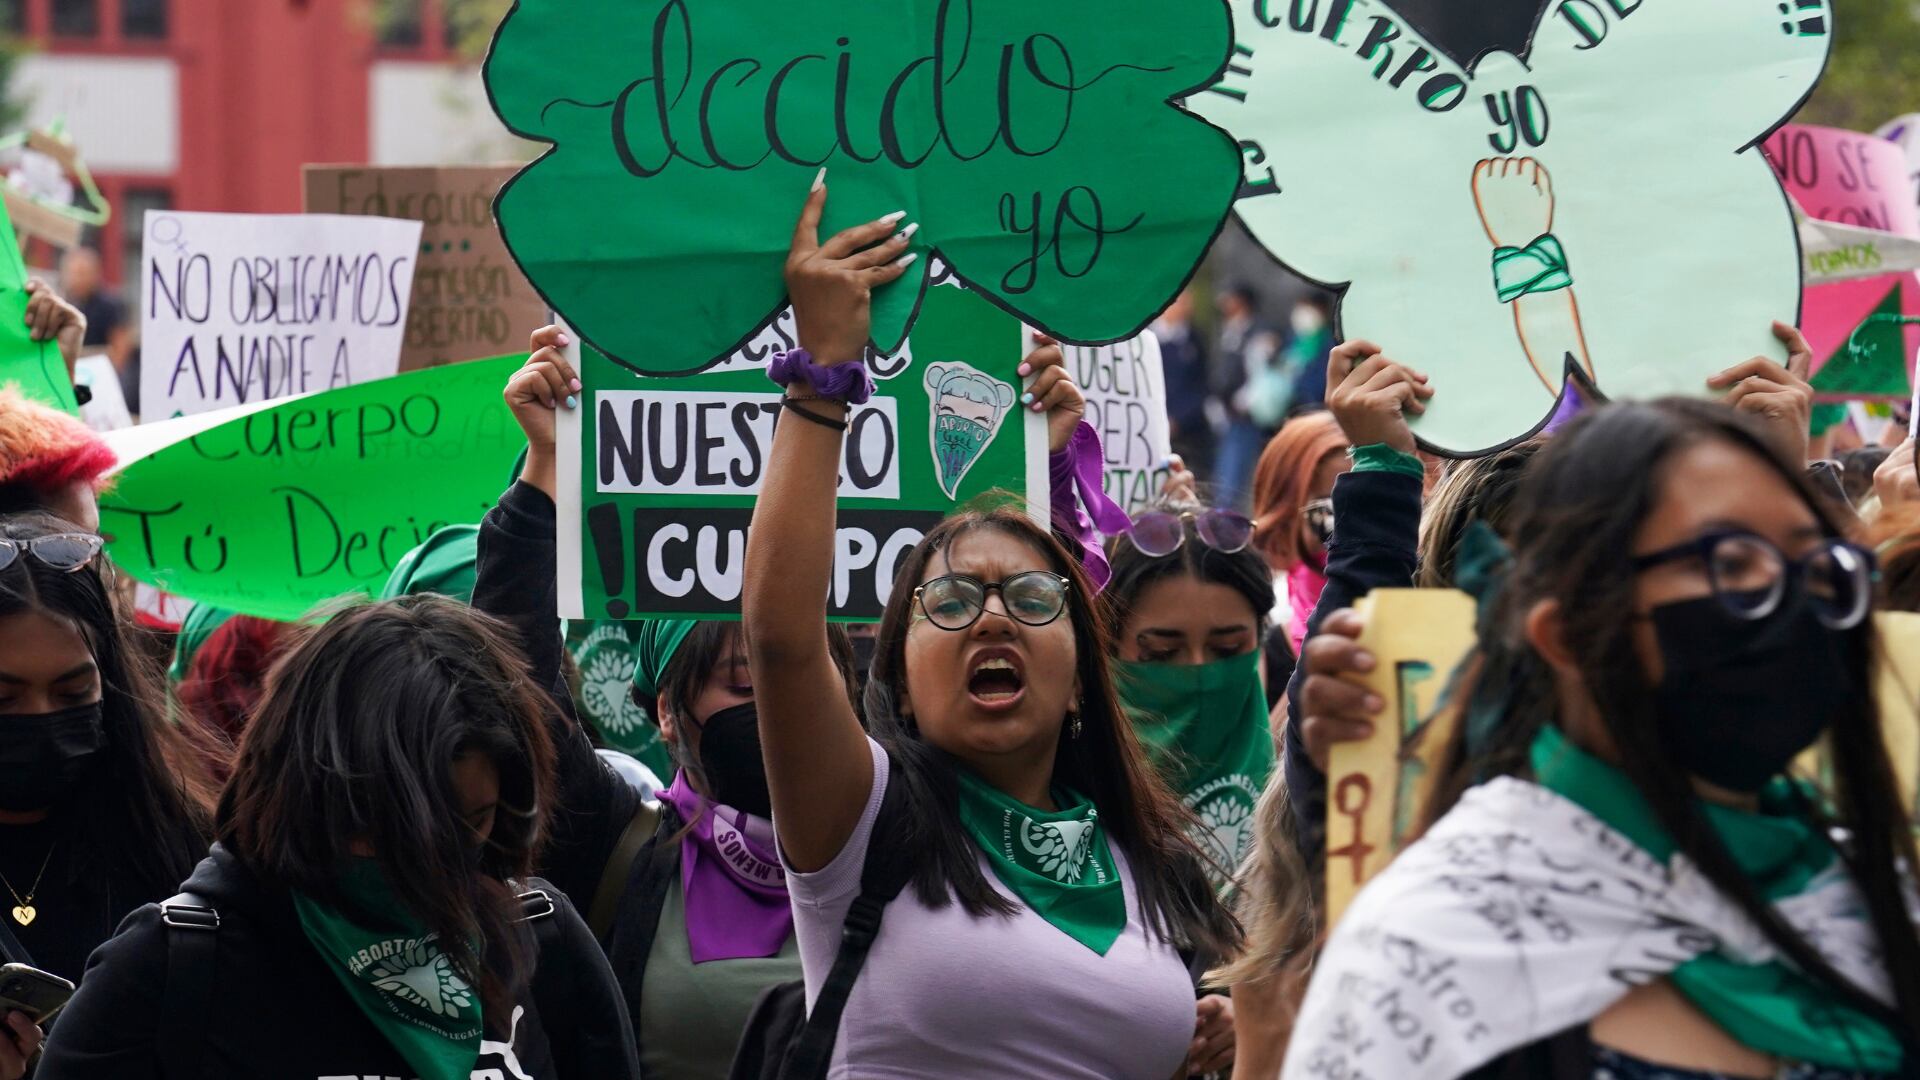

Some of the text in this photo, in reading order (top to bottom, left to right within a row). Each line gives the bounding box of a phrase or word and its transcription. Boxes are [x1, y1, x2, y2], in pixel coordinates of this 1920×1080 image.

[151, 252, 407, 326] NO OBLIGAMOS
[168, 334, 206, 400] A
[214, 334, 315, 404] NADIE
[600, 398, 894, 490] NUESO
[646, 522, 926, 609] CUPO
[717, 830, 772, 881] MENOS
